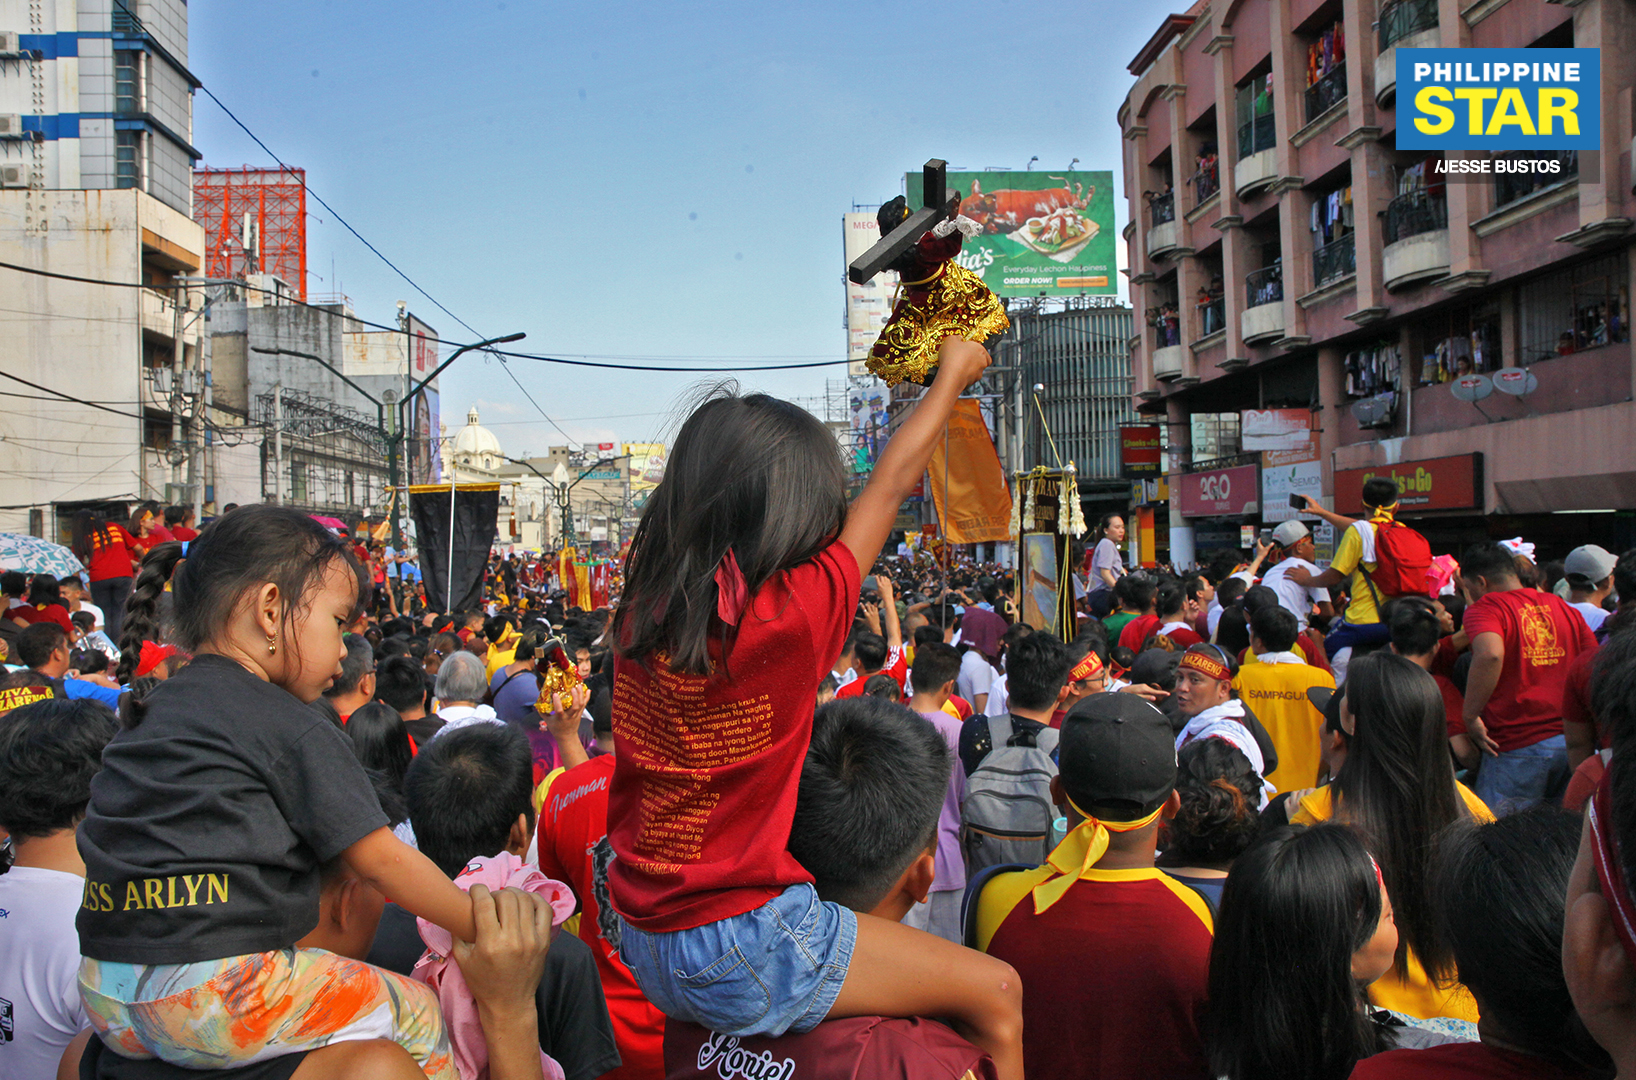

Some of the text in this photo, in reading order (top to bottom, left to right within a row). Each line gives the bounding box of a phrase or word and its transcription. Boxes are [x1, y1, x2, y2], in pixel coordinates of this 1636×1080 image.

[1004, 265, 1038, 274] Everyday
[1068, 264, 1107, 273] Happiness
[1416, 466, 1432, 492] Go
[1184, 654, 1222, 676] NAZARENO
[1532, 658, 1558, 666] Quiapo
[1072, 664, 1090, 678] VIVA
[738, 698, 756, 707] krus
[744, 703, 772, 714] naging
[702, 718, 740, 730] nagpupuri
[722, 727, 752, 737] kordero
[691, 742, 712, 750] ibaba
[725, 737, 746, 748] iyong
[747, 728, 772, 742] balikat
[613, 727, 631, 740] Aking
[724, 748, 760, 764] Patawarin
[708, 749, 728, 758] doon
[698, 800, 718, 809] ako'y
[686, 824, 704, 834] Diyos
[123, 874, 230, 911] ARLYN
